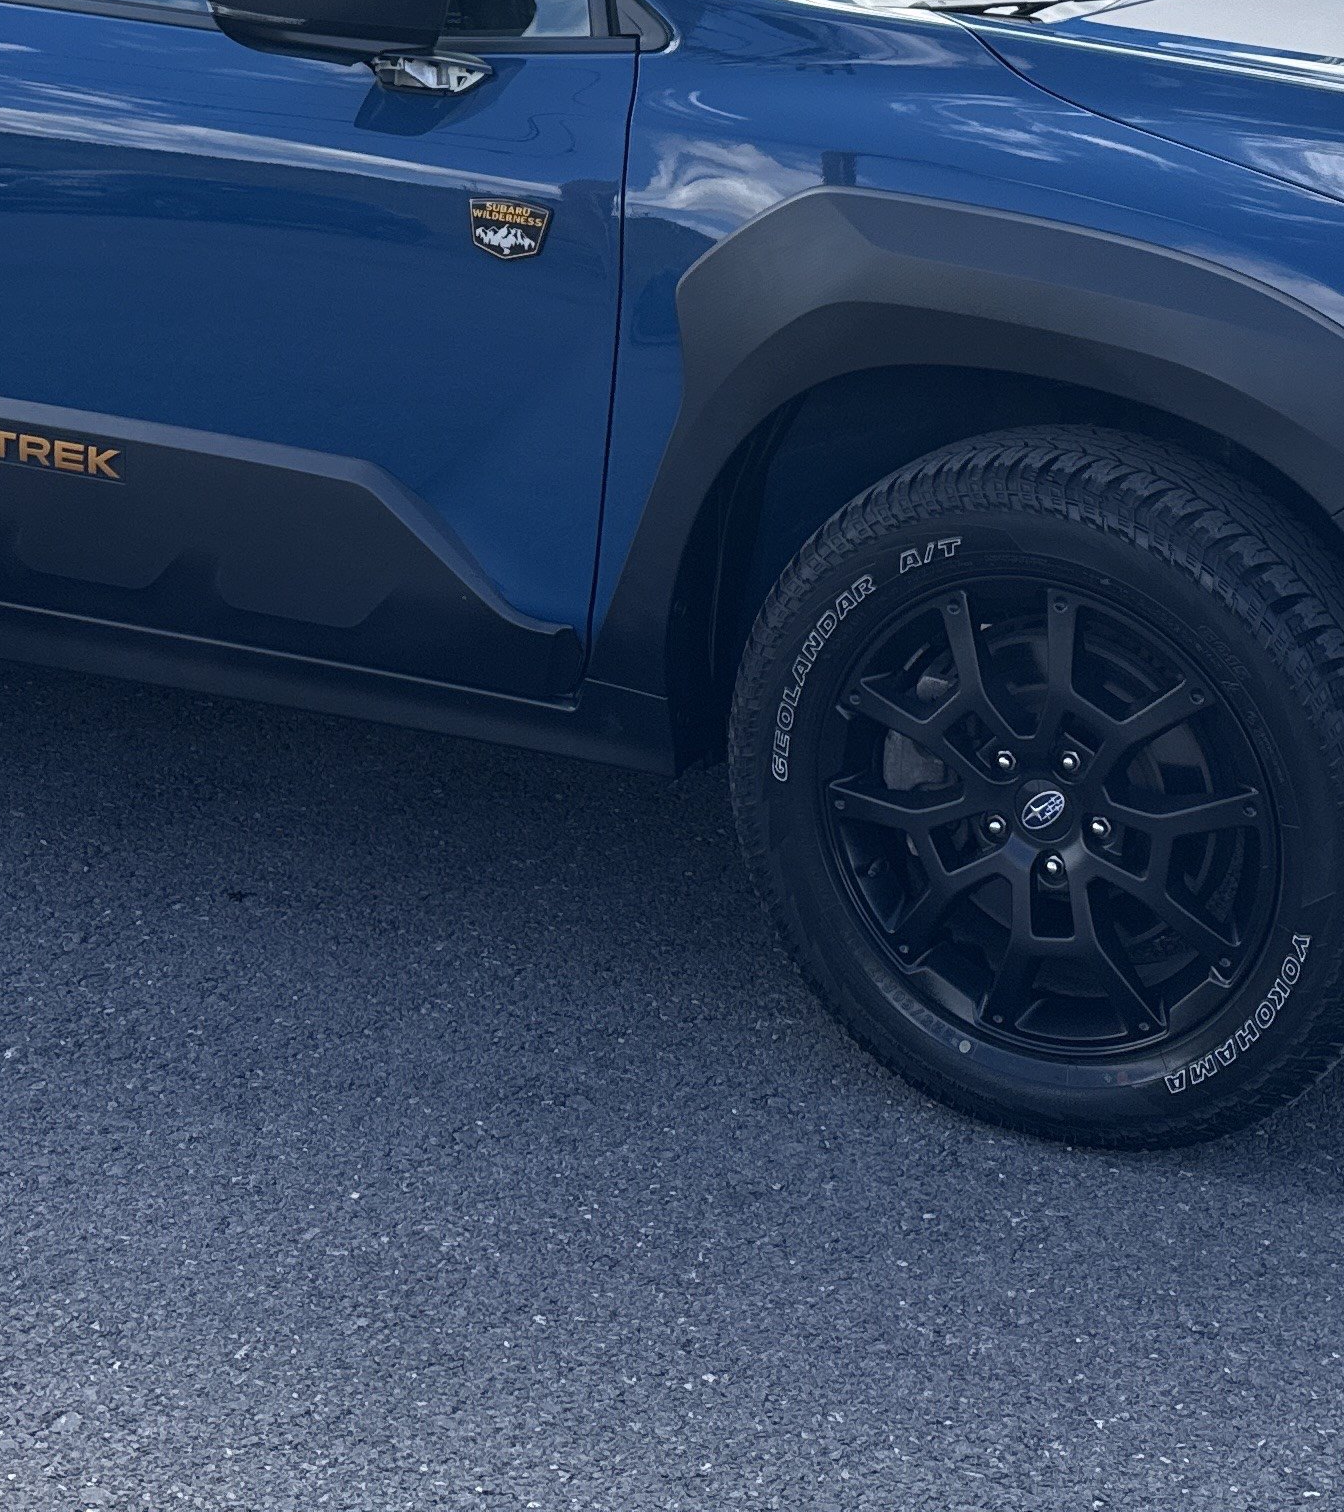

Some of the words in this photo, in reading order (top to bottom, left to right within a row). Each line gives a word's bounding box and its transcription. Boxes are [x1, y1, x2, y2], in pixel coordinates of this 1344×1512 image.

[472, 208, 543, 227] WILDERNESS
[486, 201, 531, 217] SUBARU
[771, 573, 877, 783] GEOLANDAR
[898, 536, 963, 574] A/T
[1164, 933, 1312, 1094] YOKOHAMA
